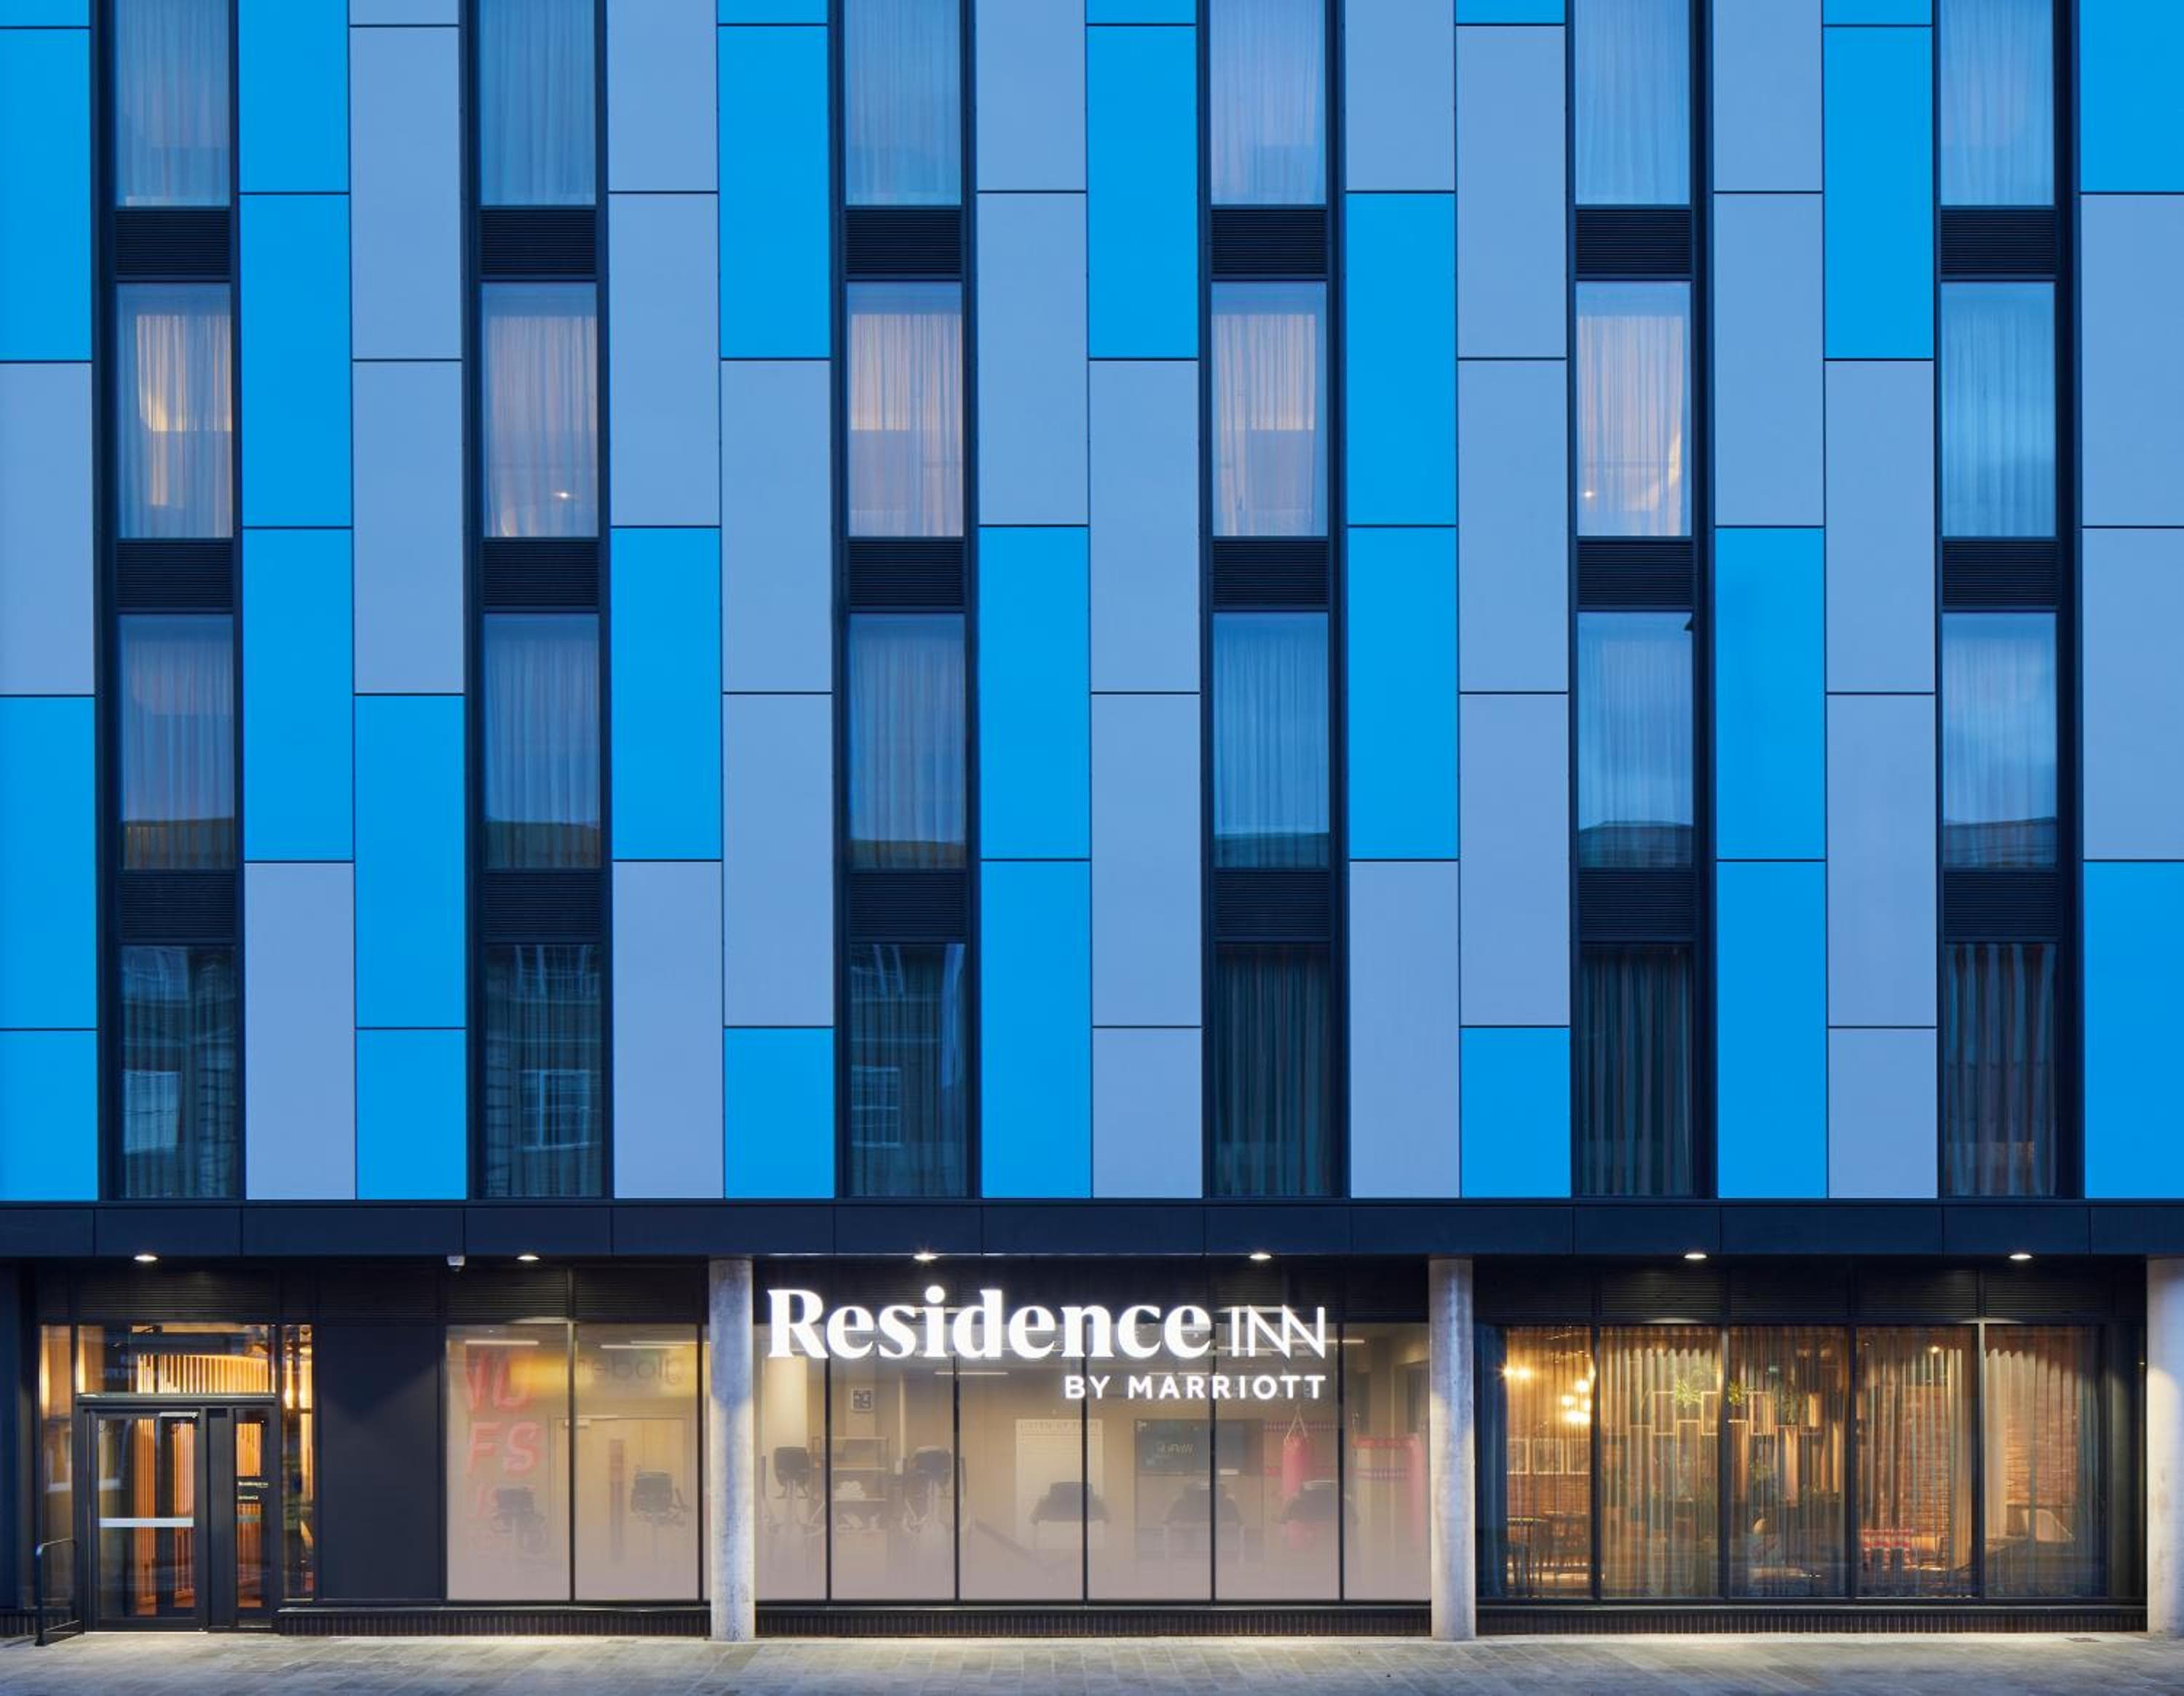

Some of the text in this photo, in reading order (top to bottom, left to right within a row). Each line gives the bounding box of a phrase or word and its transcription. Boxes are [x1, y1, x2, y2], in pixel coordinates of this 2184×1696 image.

[767, 1285, 1326, 1360] Residence INN
[1064, 1375, 1326, 1400] BY MARRIOTT
